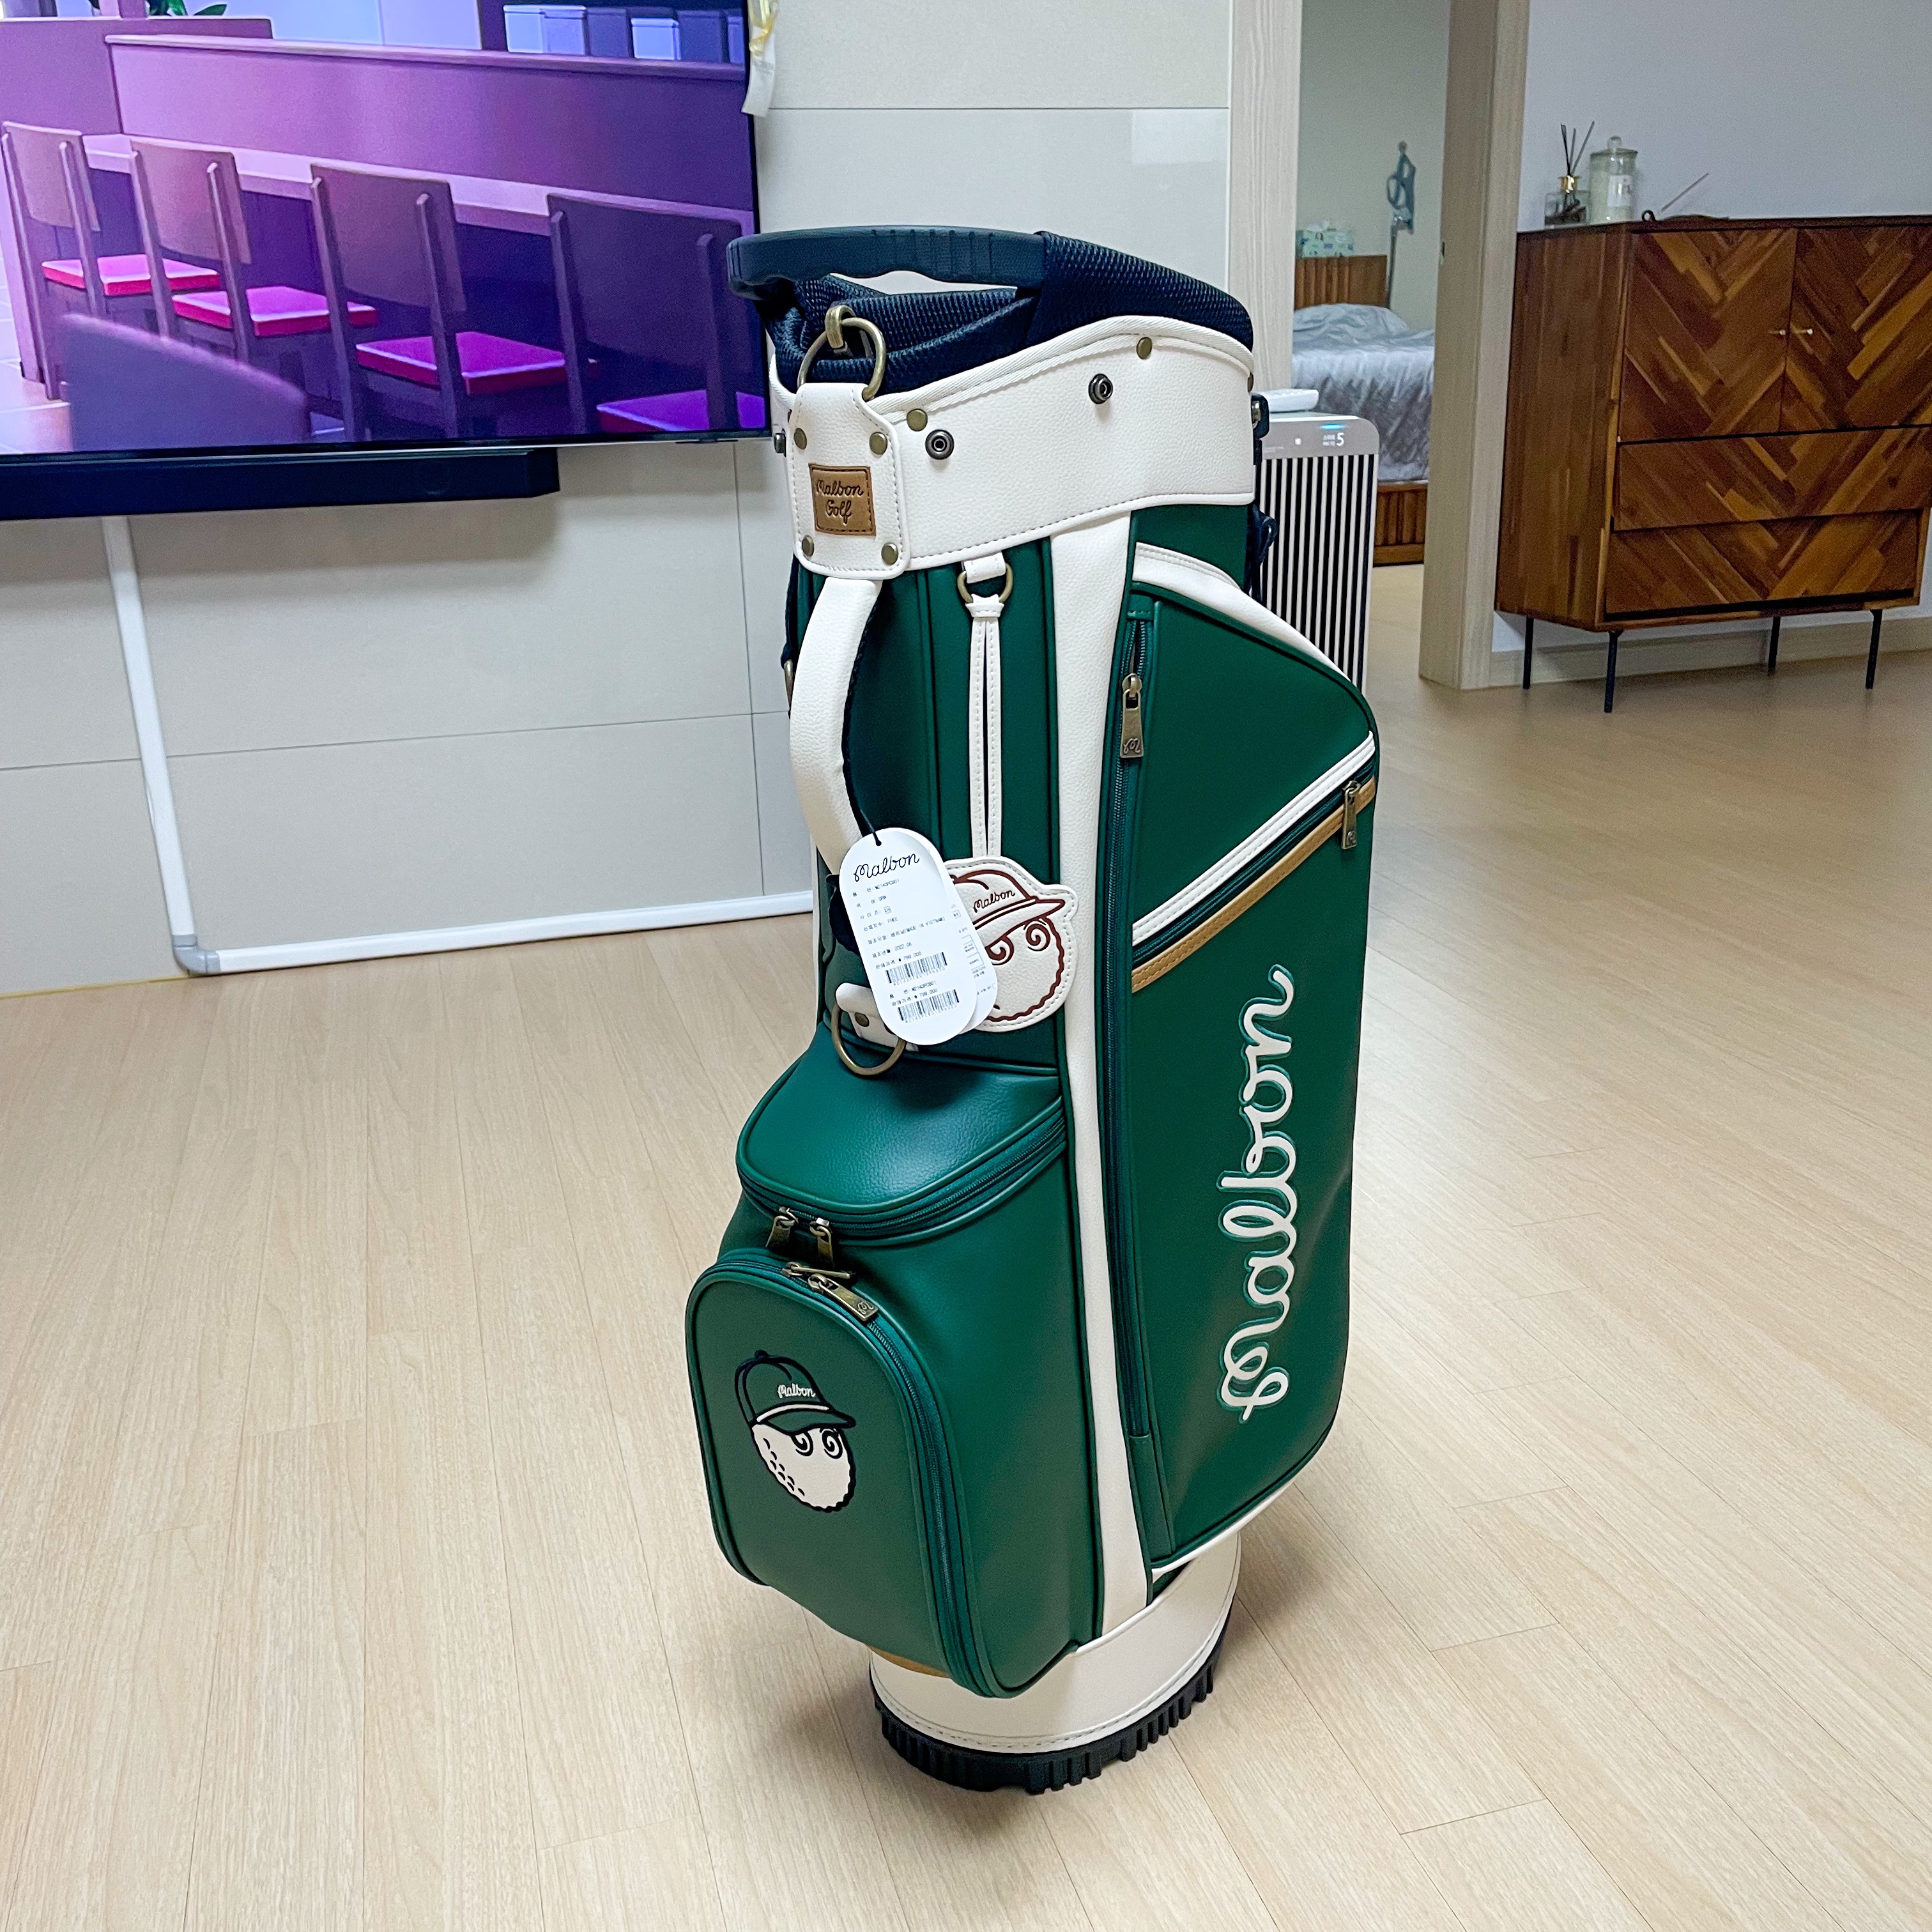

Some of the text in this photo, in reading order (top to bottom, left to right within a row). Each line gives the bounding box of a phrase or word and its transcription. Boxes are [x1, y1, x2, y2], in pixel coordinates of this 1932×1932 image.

[1336, 432, 1345, 447] 5
[816, 479, 864, 496] Malbon
[826, 500, 852, 525] Golf
[853, 853, 920, 882] Malbon
[973, 889, 1015, 913] Malbon
[1216, 964, 1297, 1423] Malbon
[778, 1383, 816, 1399] Malbon
